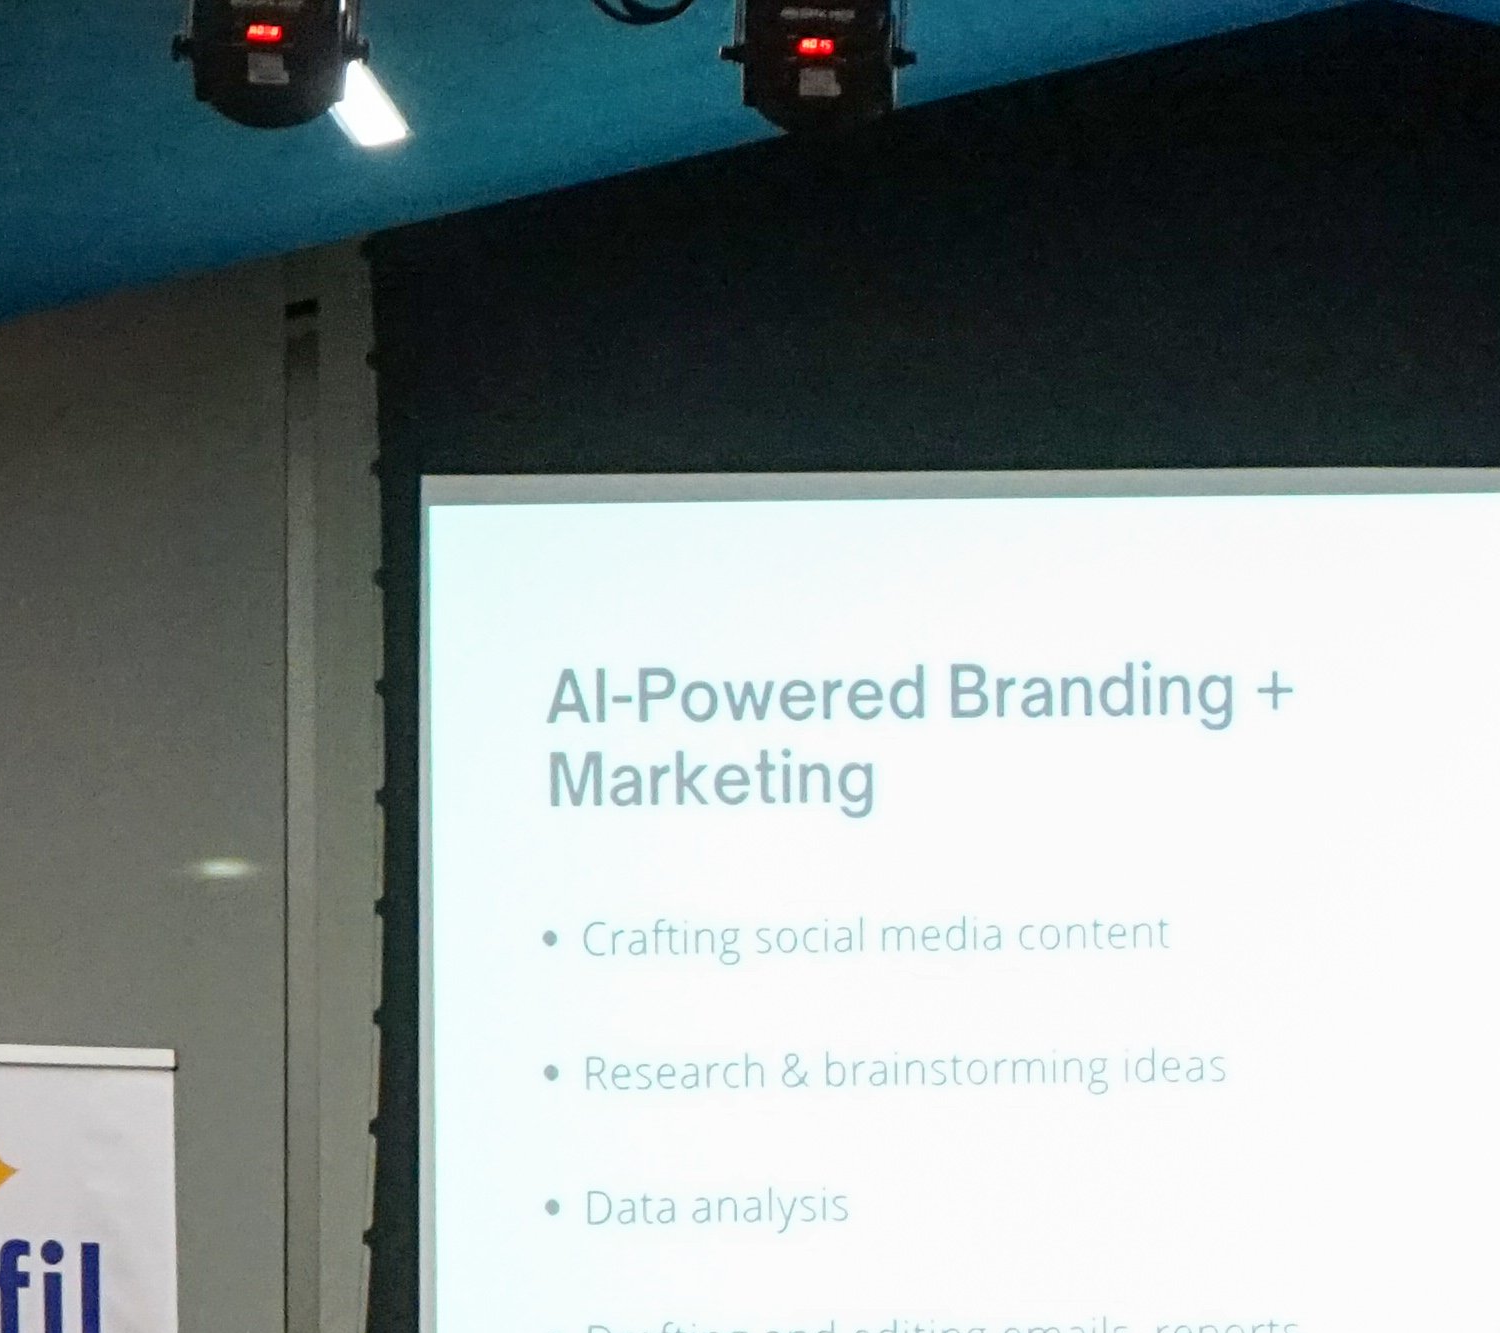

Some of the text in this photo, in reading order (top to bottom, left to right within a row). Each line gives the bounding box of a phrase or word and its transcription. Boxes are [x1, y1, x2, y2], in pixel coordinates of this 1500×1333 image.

[547, 661, 1294, 731] AI-Powered Branding +
[550, 748, 873, 818] Marketing
[583, 916, 1169, 965] Crafting social media content
[585, 1048, 1226, 1095] Research & brainstorming ideas
[587, 1187, 849, 1235] Data analysis
